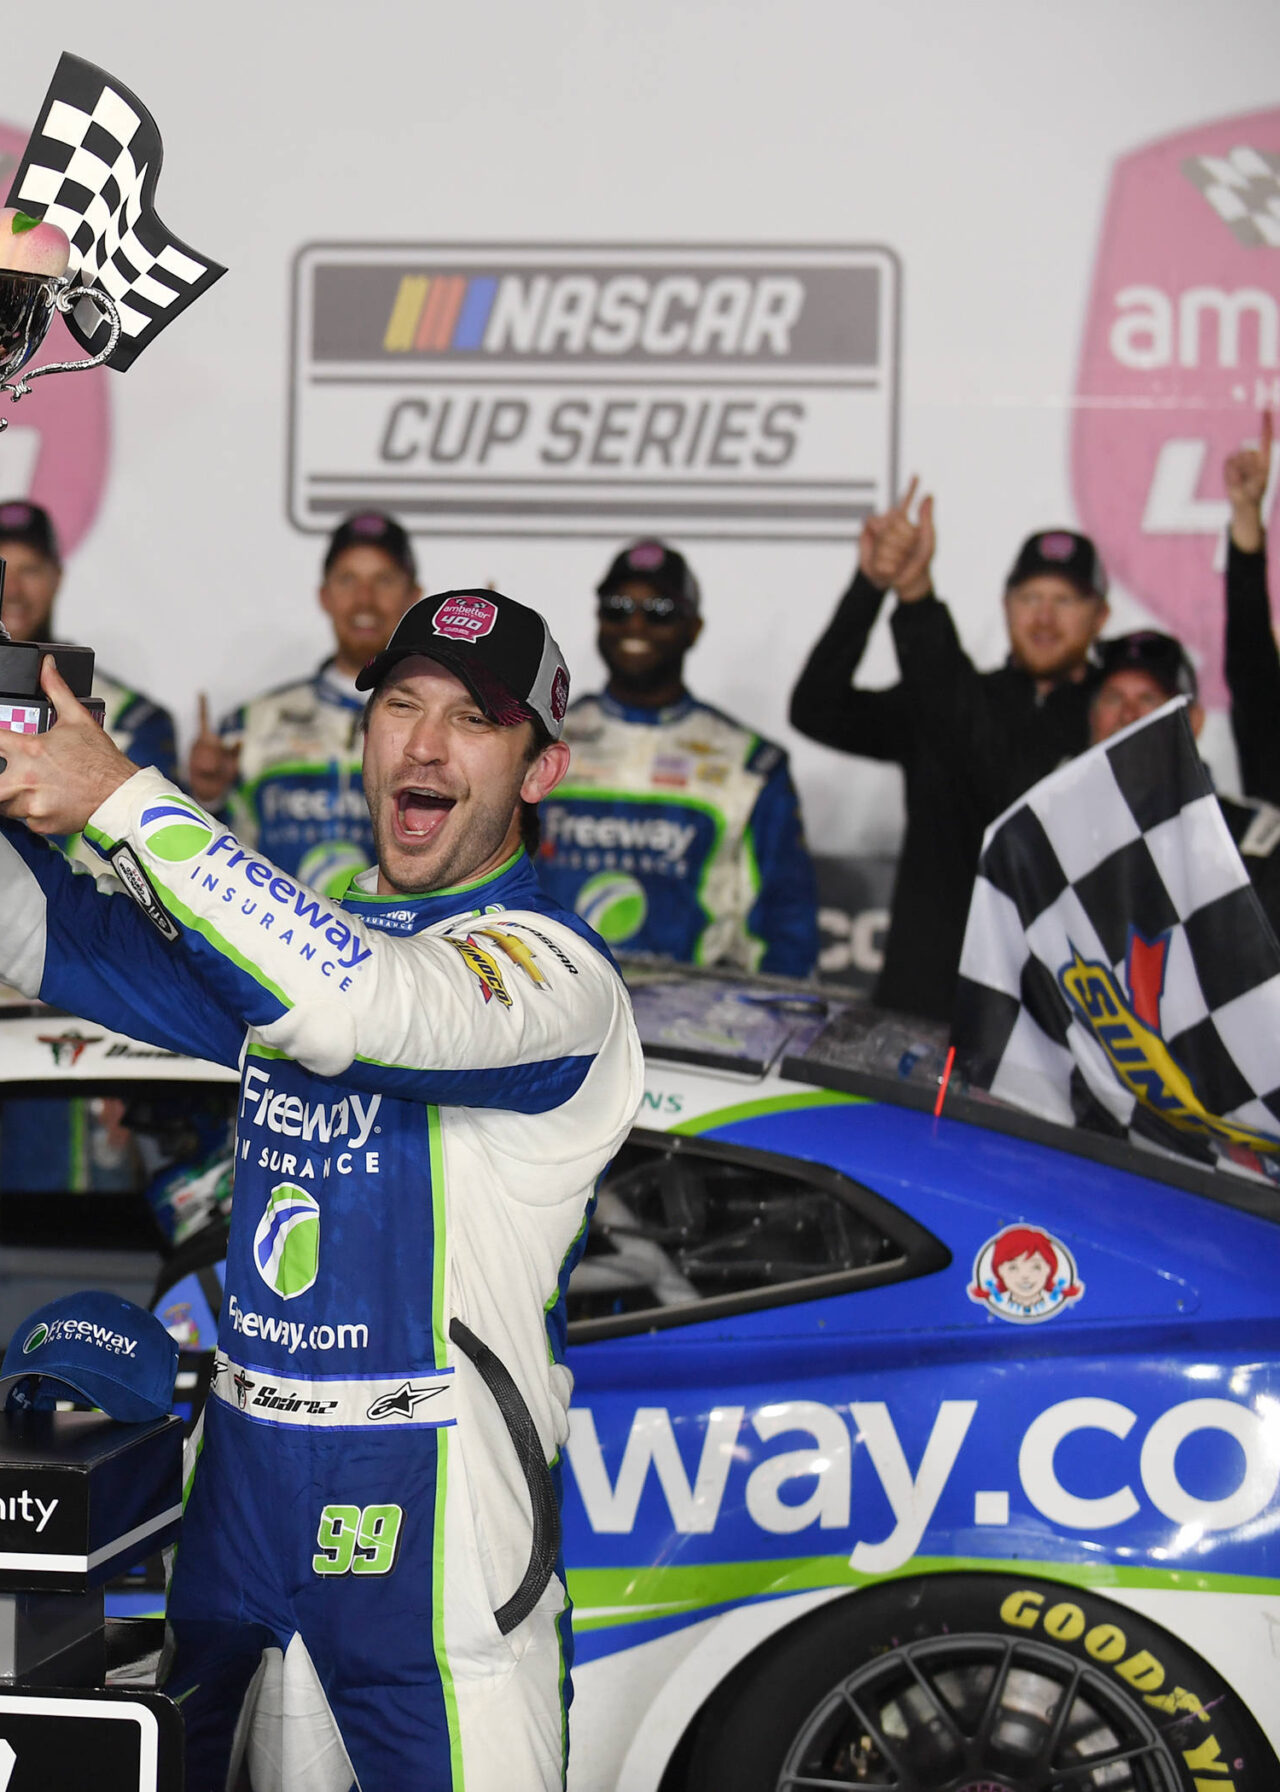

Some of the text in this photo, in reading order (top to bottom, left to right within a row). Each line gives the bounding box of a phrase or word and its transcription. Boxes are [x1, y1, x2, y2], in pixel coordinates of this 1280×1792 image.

[484, 275, 806, 356] NASCAR
[379, 397, 806, 469] CUP SERIES
[440, 615, 483, 631] 400
[443, 605, 490, 619] ambetter
[545, 806, 697, 864] Freeway
[190, 866, 353, 993] INSURANCE
[206, 835, 373, 969] Freeway
[240, 1065, 383, 1149] Freeway
[44, 1332, 121, 1355] INSURANCE
[47, 1319, 138, 1355] Freeway
[228, 1294, 369, 1355] Freeway.com
[312, 1503, 407, 1578] 99
